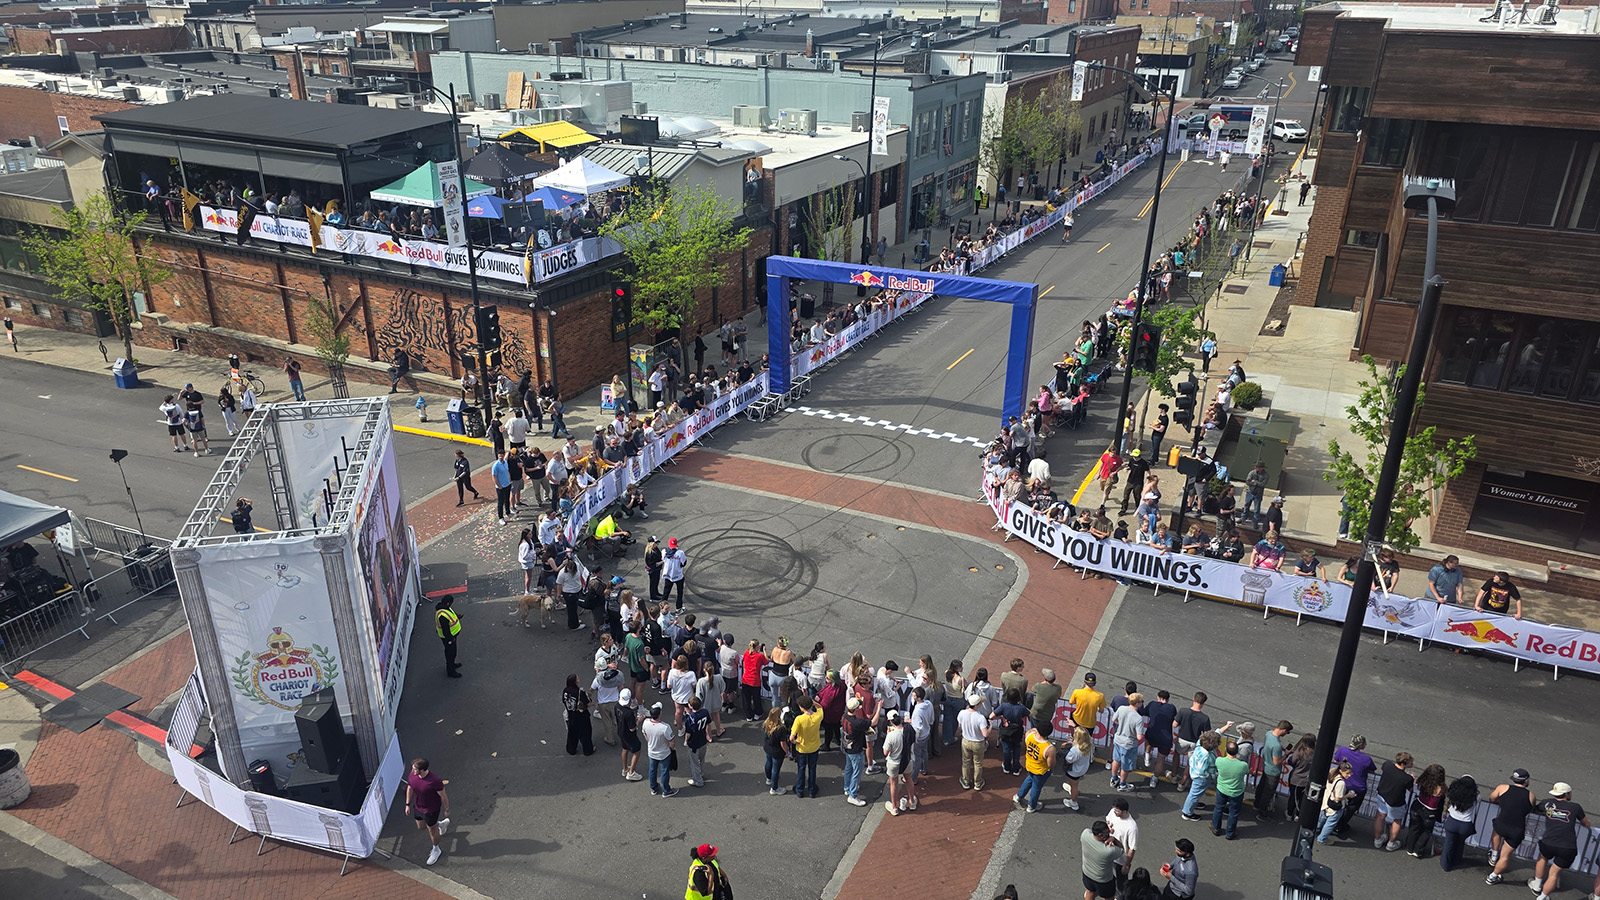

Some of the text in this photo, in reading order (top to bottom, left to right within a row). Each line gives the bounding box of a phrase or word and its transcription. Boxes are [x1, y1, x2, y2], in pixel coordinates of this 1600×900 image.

[262, 222, 290, 236] CHARIOT
[405, 246, 425, 259] Red
[426, 249, 444, 263] Bull
[444, 251, 467, 267] GIVES
[474, 257, 487, 270] OU
[542, 249, 578, 278] JUDGES
[889, 275, 934, 292] Red Bull
[687, 417, 701, 437] Red
[702, 408, 715, 427] Bull
[715, 403, 731, 418] GIVES
[731, 393, 744, 408] YOU
[589, 485, 606, 510] RACE
[1490, 486, 1578, 509] Women's Haircuts
[1012, 508, 1056, 548] GIVES
[1061, 532, 1104, 565] YOU
[1111, 546, 1209, 589] WIIINGS.
[1525, 633, 1577, 658] Red
[261, 667, 313, 682] Red Bull
[269, 680, 309, 692] CHARIOT
[280, 690, 303, 701] RACE
[697, 717, 707, 731] 77
[1027, 746, 1039, 761] 25
